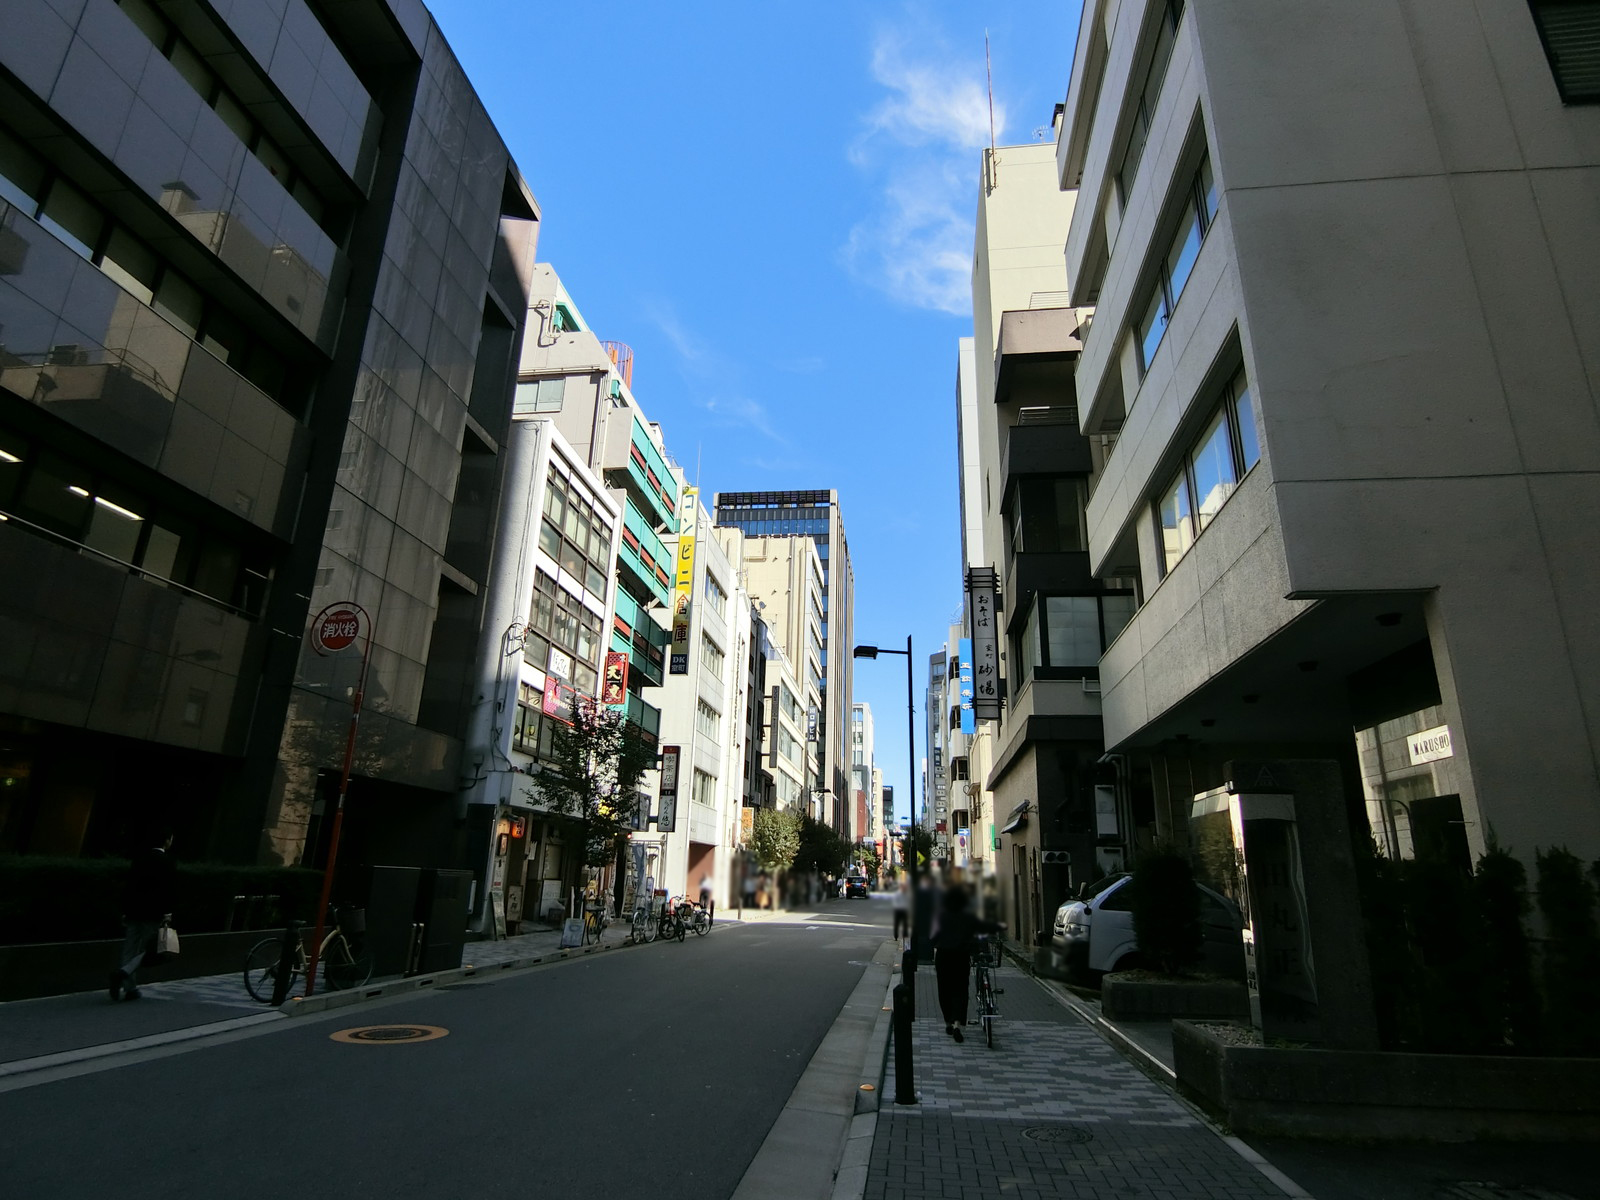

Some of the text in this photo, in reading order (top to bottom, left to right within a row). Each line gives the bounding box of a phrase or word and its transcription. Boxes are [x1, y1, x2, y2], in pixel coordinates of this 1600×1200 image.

[674, 494, 695, 644] コンビニ倉庫
[977, 595, 990, 627] おそば
[322, 621, 357, 639] 消火栓
[978, 662, 995, 696] 砂場
[1413, 734, 1450, 756] MARUSHO
